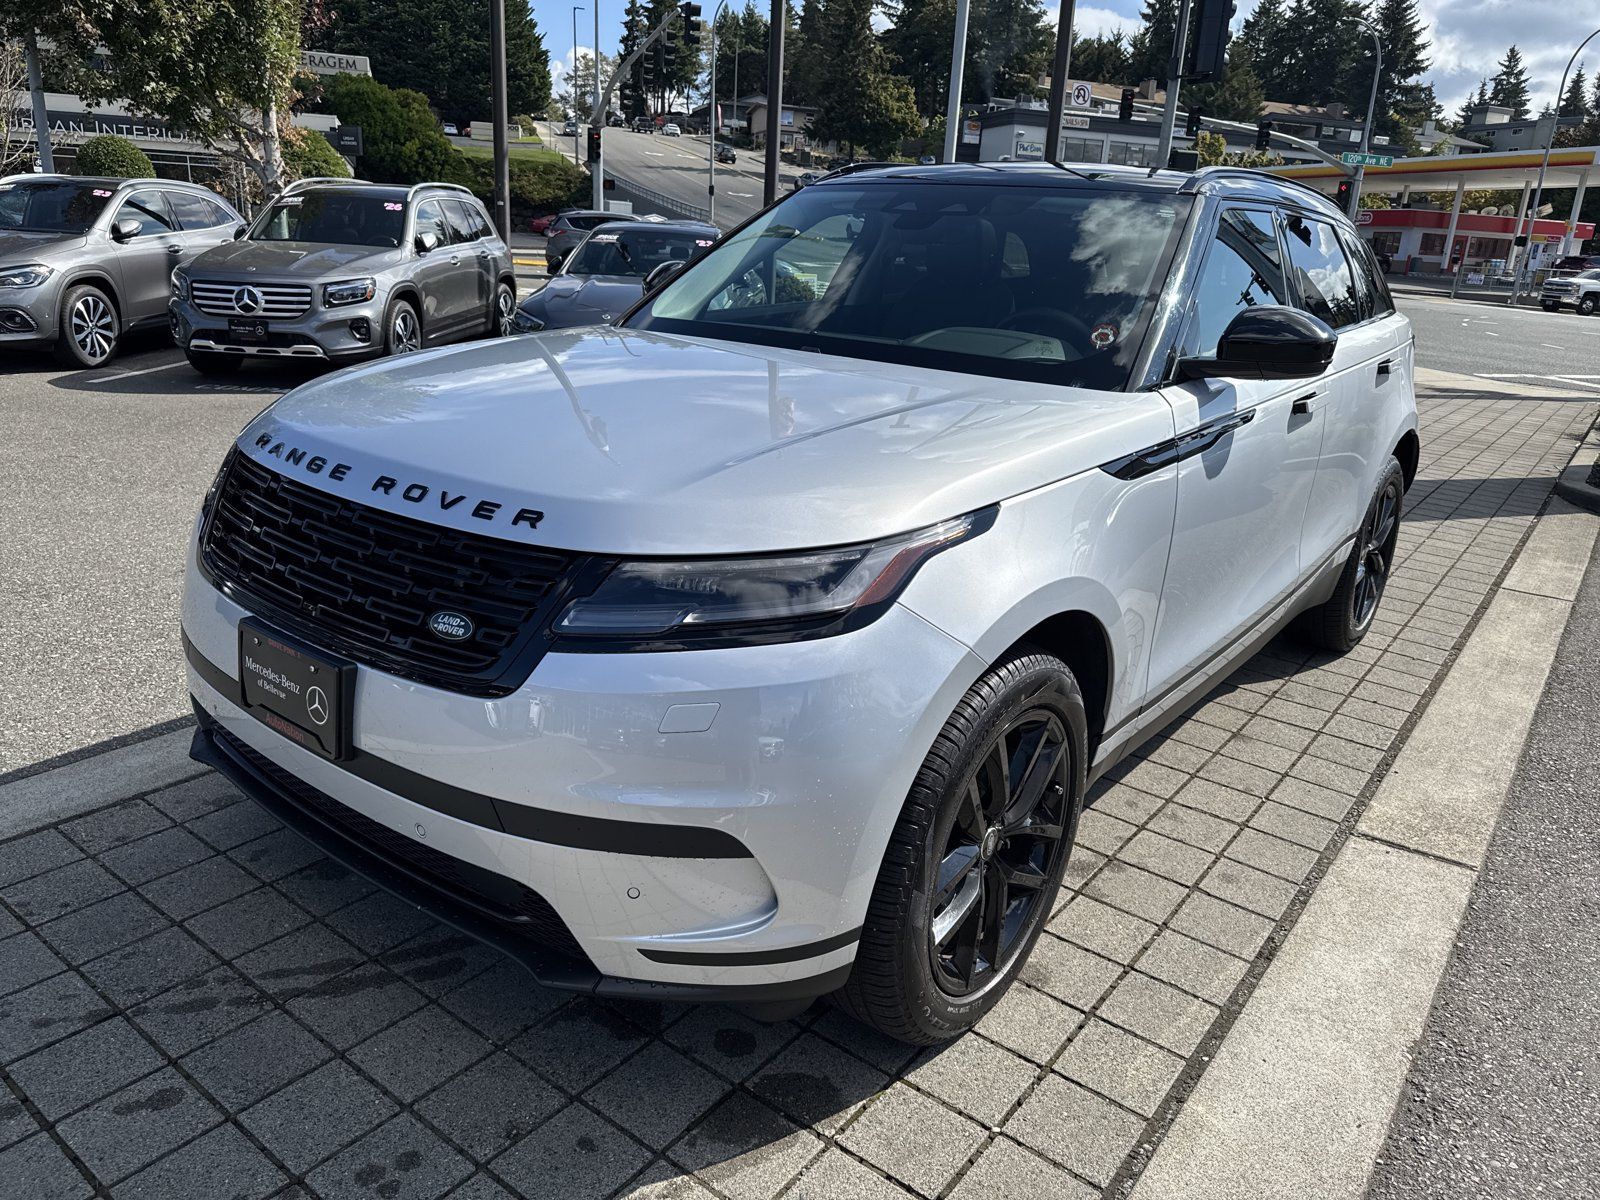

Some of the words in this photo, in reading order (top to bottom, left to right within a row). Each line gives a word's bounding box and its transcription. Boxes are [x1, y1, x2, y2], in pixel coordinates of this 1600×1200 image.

[10, 116, 85, 137] URAN
[1347, 154, 1363, 163] 120th
[1365, 156, 1376, 165] Ave
[1379, 157, 1389, 166] NE
[255, 432, 352, 482] RANGE
[371, 475, 546, 530] ROVER
[437, 614, 461, 626] LAND
[437, 623, 465, 636] ROVER
[245, 655, 300, 695] Mercedes-Benz
[257, 679, 263, 688] of
[263, 680, 287, 700] Bellevue
[265, 711, 304, 743] AutoNation
